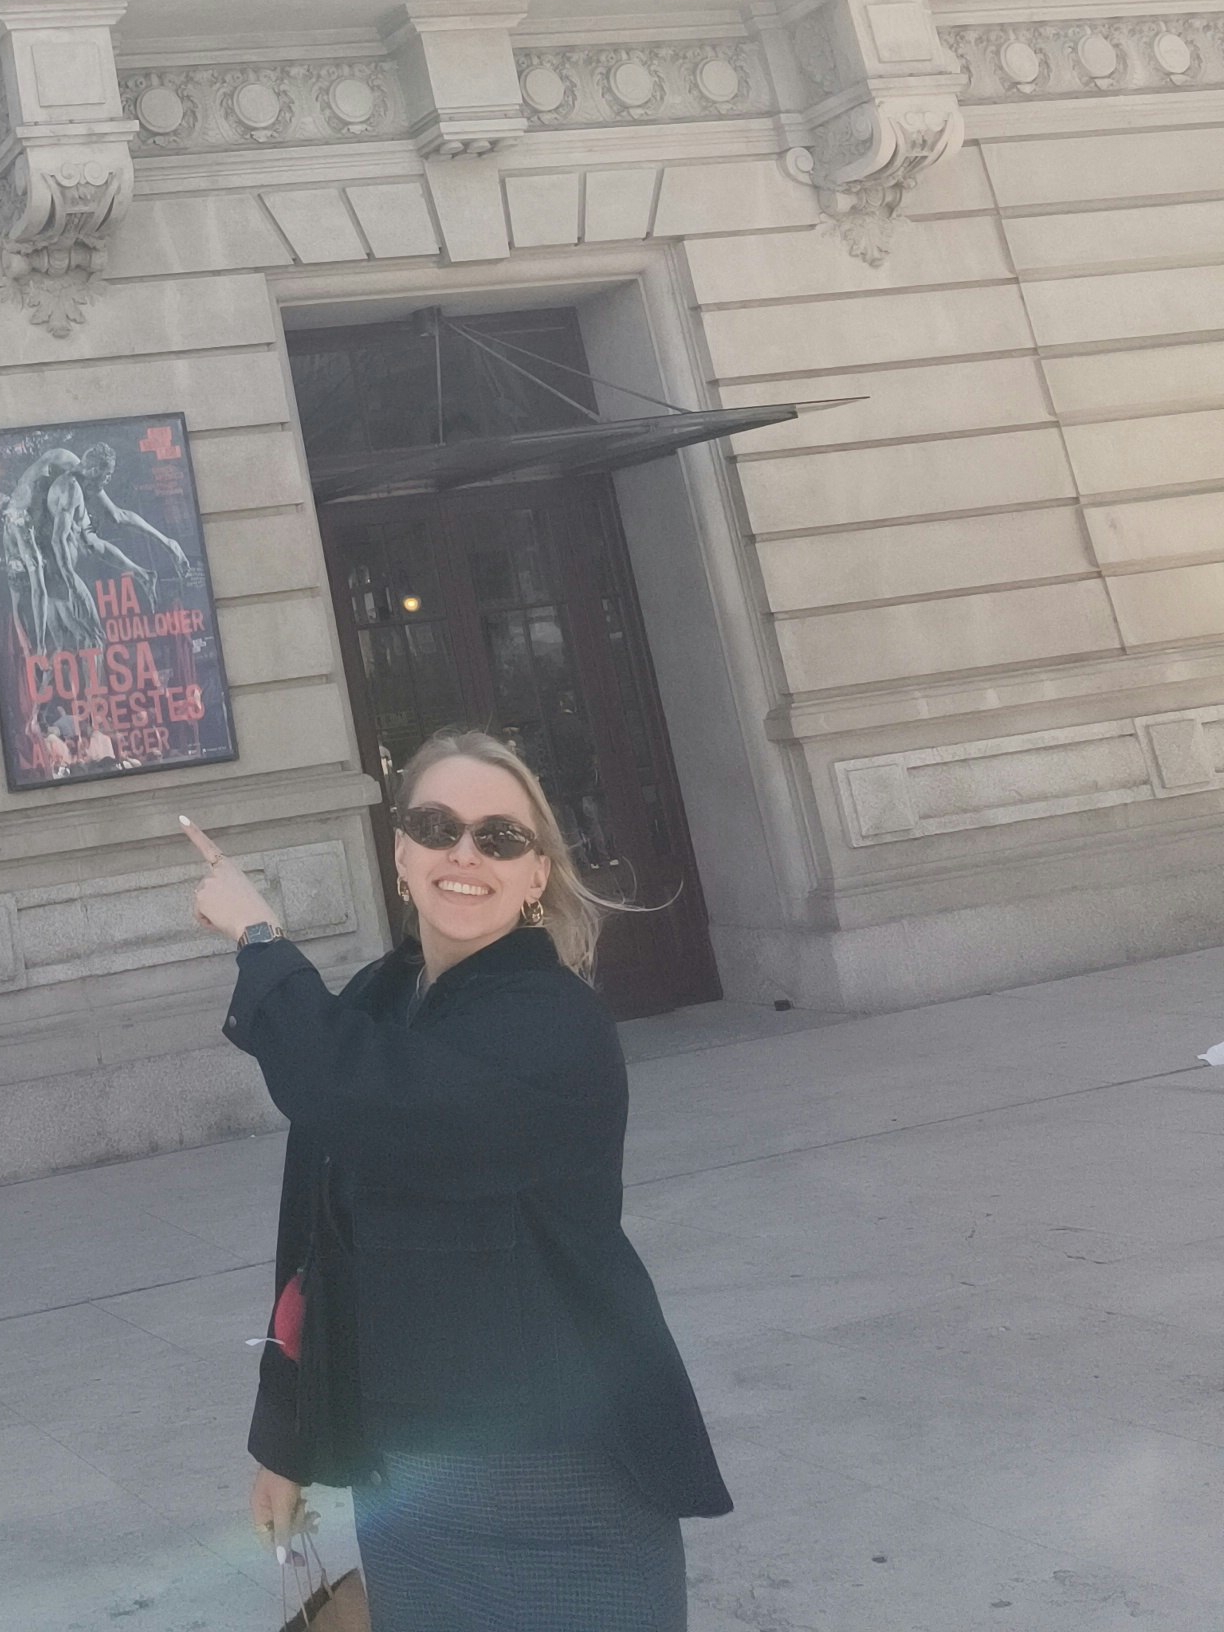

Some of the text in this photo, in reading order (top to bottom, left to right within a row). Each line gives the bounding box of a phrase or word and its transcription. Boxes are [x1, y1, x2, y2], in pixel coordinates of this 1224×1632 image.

[105, 609, 205, 643] QUALQUER
[26, 641, 161, 704] COISA
[71, 683, 205, 734] PRESTES
